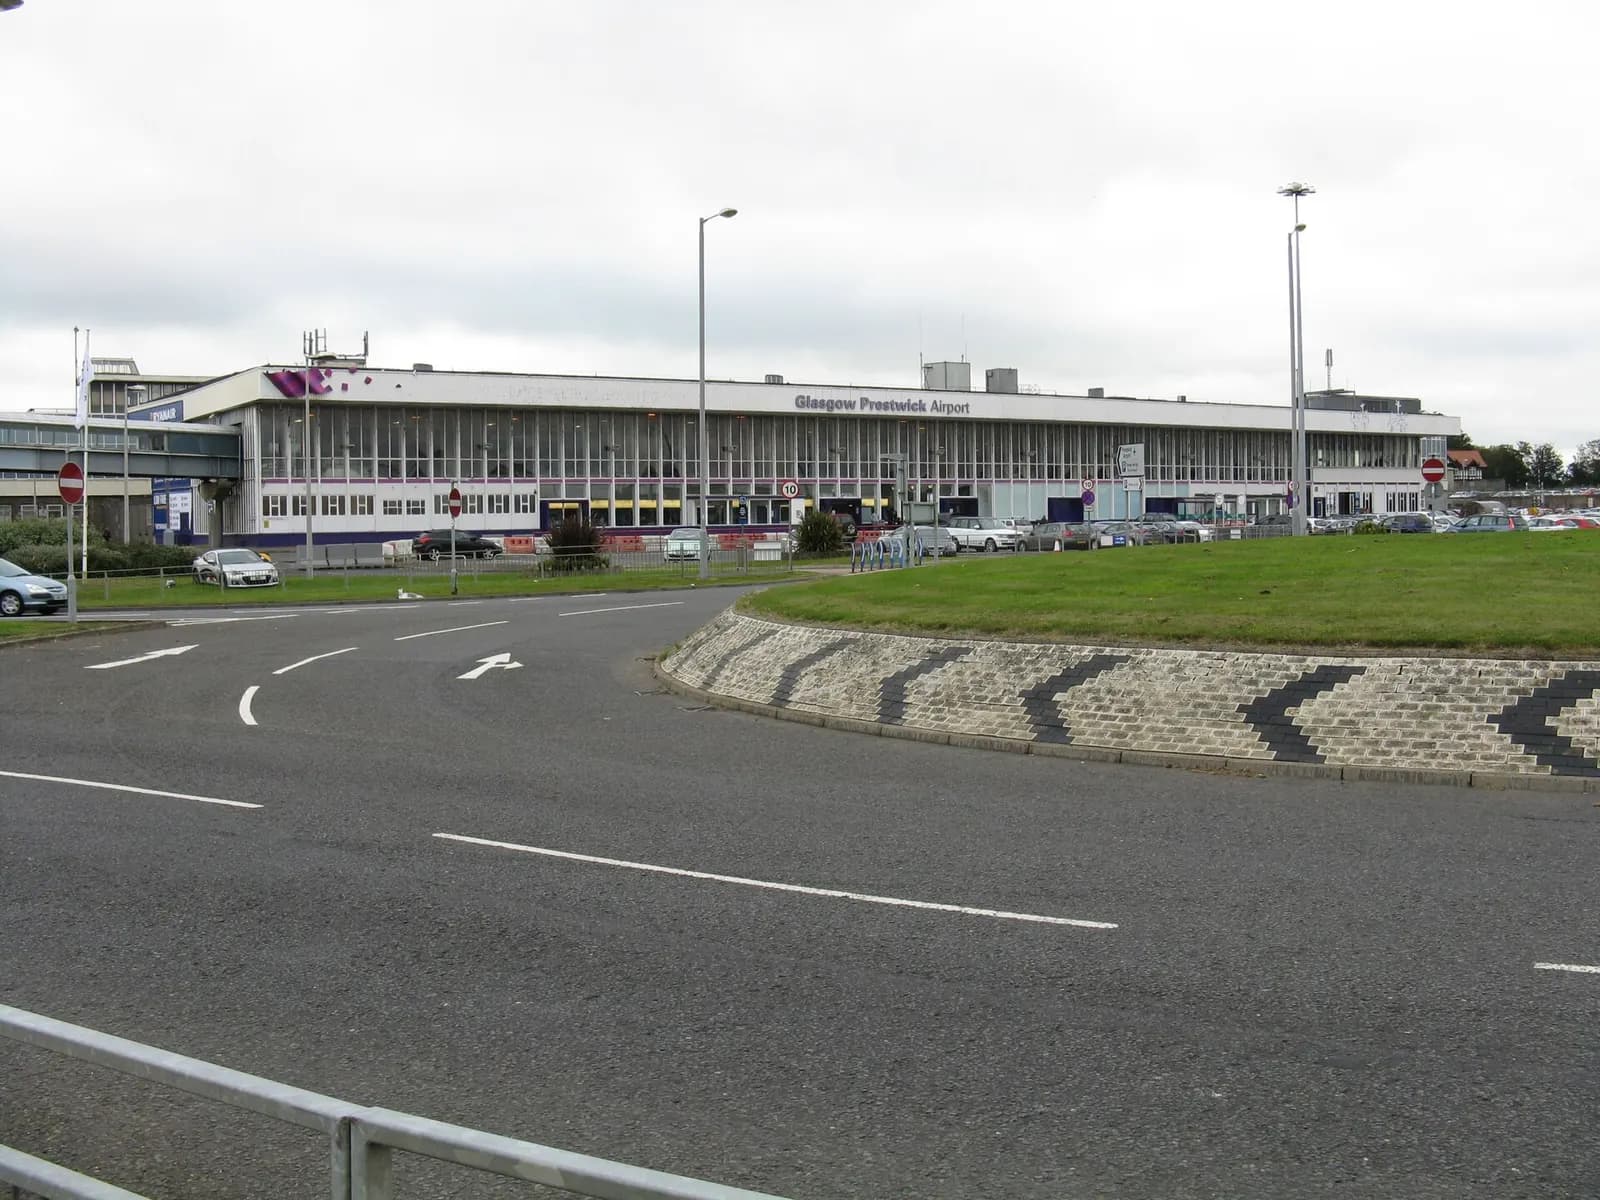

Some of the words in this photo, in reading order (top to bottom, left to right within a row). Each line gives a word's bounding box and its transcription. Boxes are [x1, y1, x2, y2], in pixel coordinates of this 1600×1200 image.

[795, 395, 856, 411] Glasgow
[860, 397, 926, 412] Prestwick
[930, 400, 970, 414] Airport
[785, 485, 796, 494] 10
